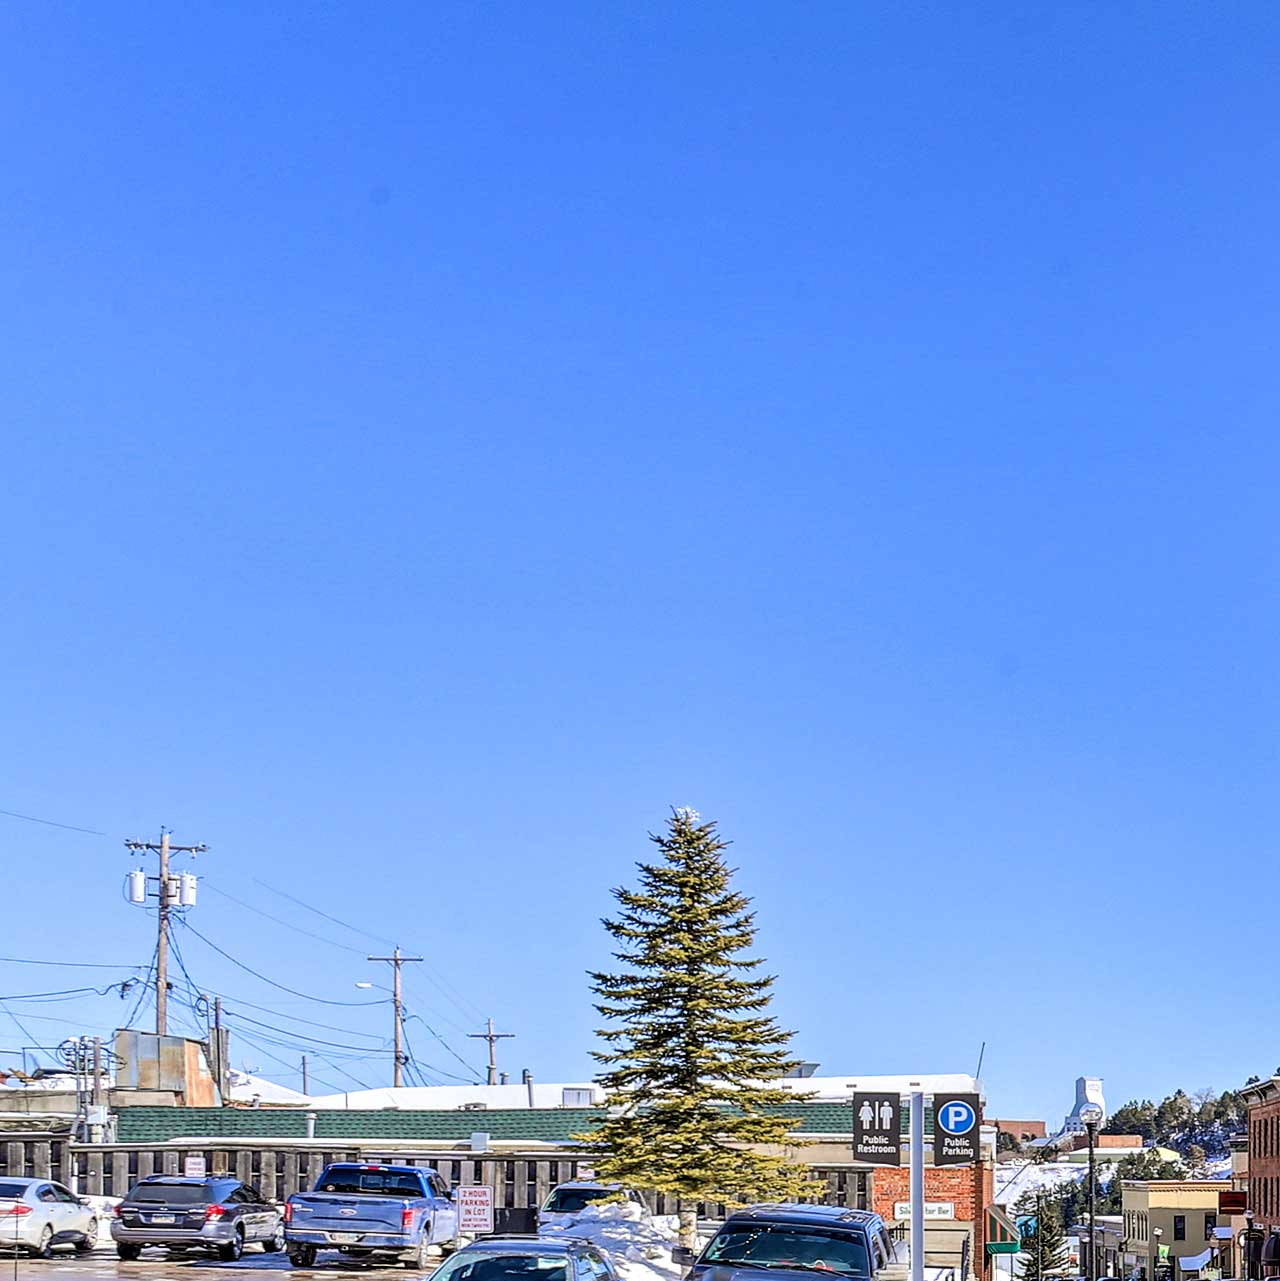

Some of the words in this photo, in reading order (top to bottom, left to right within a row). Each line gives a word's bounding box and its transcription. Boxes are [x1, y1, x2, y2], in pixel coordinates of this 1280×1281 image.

[862, 1135, 889, 1144] Public
[944, 1138, 970, 1147] Public
[857, 1144, 896, 1153] Restroom
[942, 1147, 974, 1158] Parking
